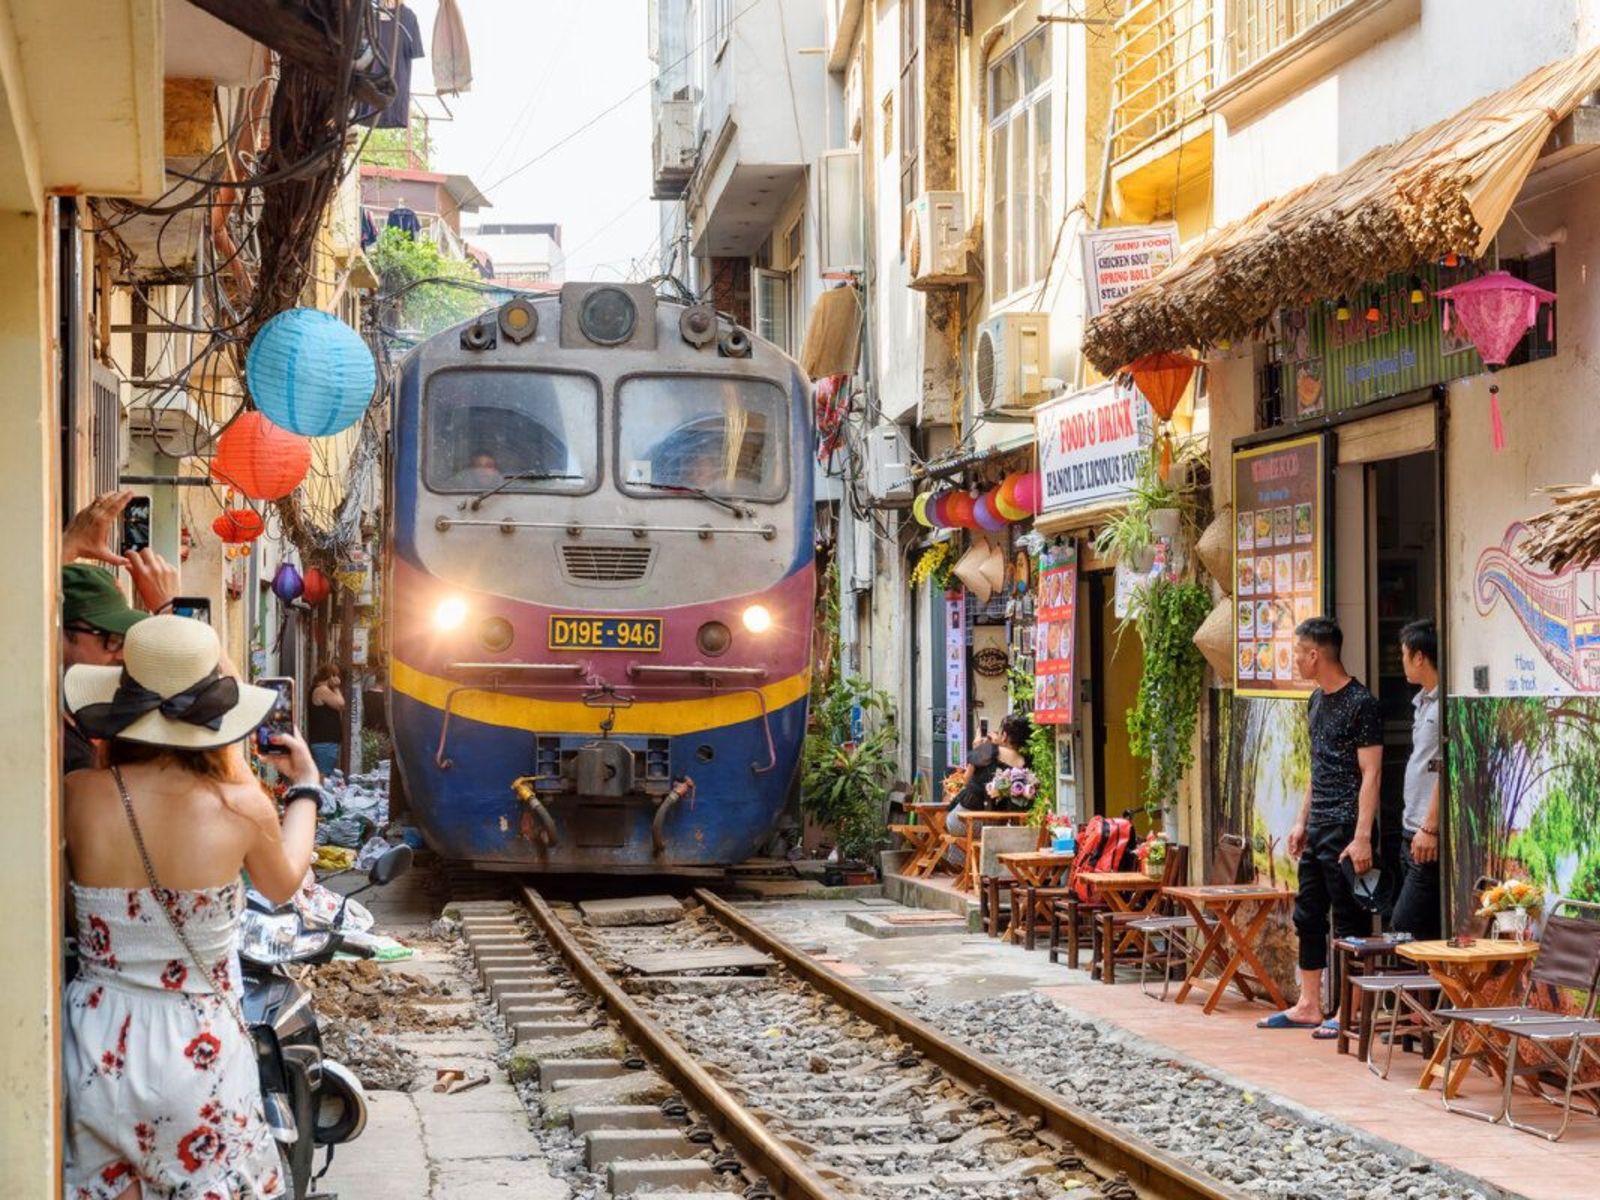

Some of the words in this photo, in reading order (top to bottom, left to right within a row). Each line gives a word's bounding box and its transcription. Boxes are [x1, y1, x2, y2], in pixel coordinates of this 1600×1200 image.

[1114, 241, 1140, 251] MENU
[1142, 238, 1170, 248] FOOD
[1098, 255, 1130, 269] CHICKEN
[1130, 252, 1150, 266] SOUP
[1100, 271, 1128, 285] SPRING
[1101, 286, 1129, 300] STEAM
[1060, 409, 1087, 454] FOOD
[1087, 409, 1096, 446] &
[1097, 398, 1134, 443] DRINK
